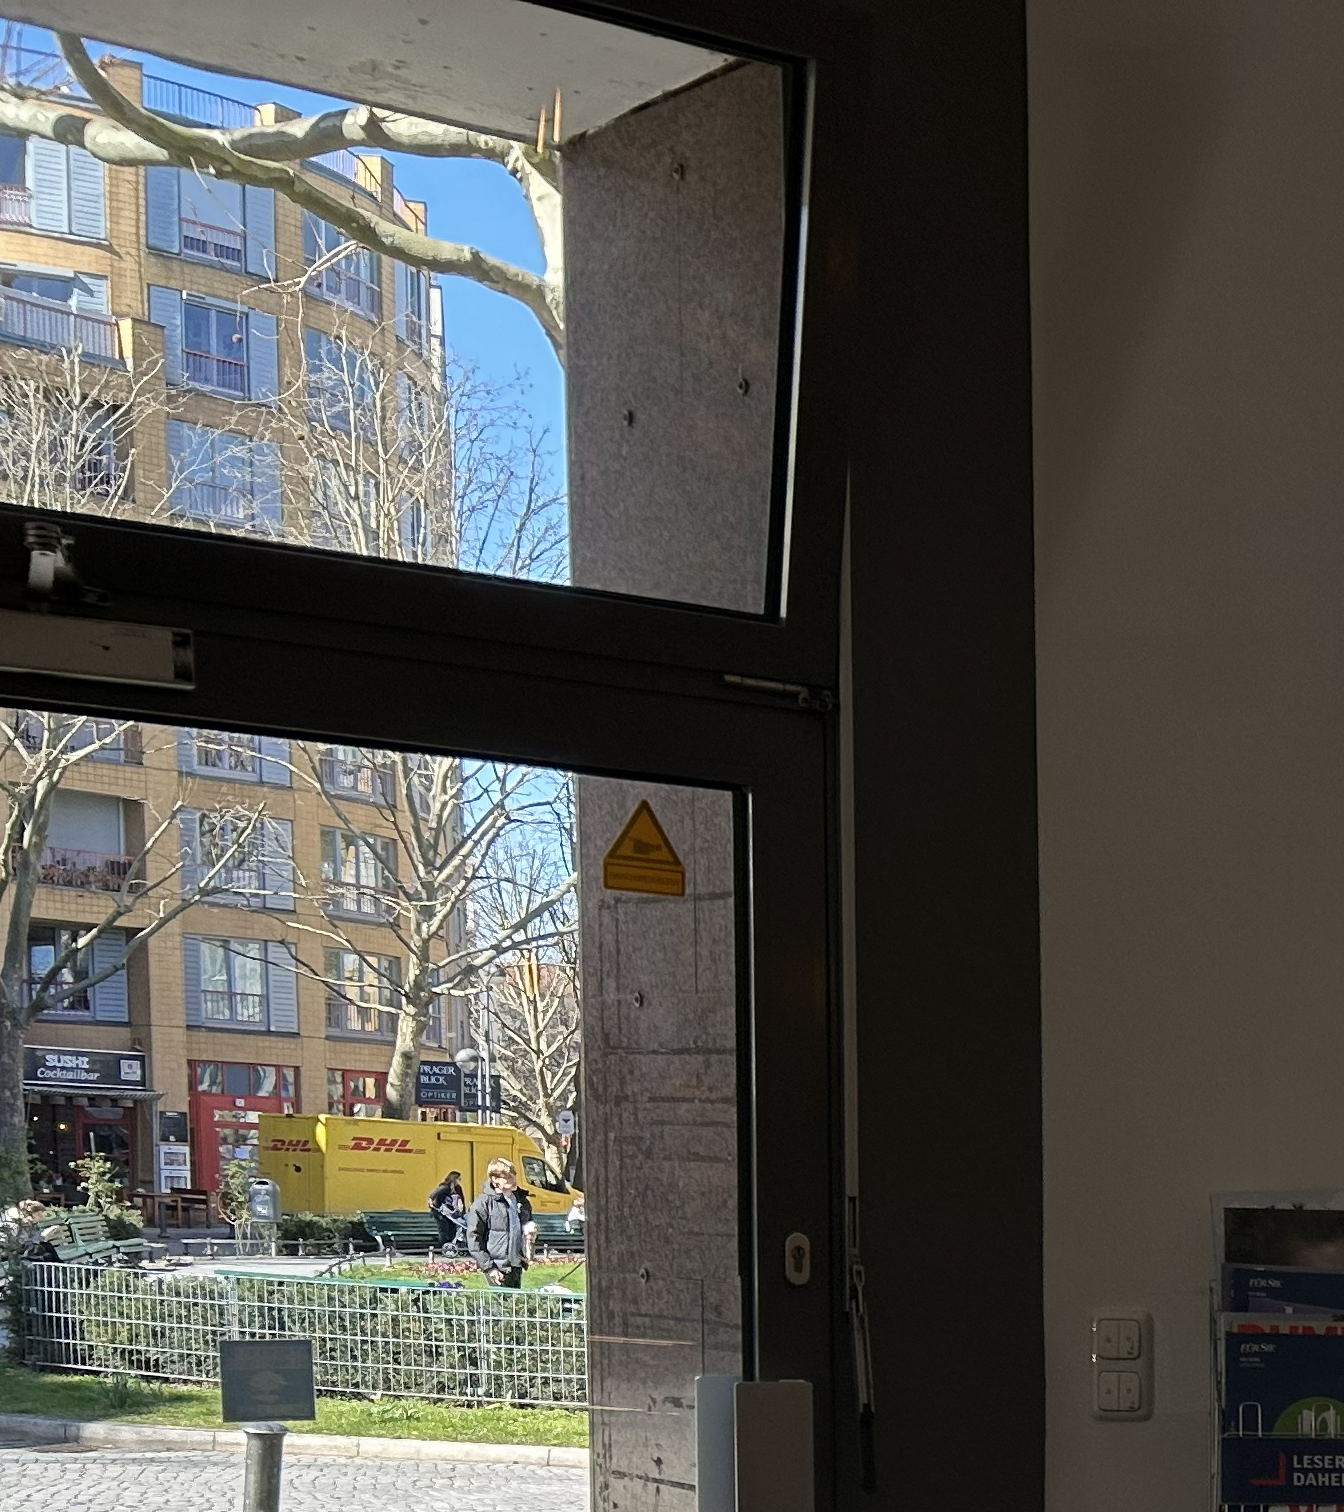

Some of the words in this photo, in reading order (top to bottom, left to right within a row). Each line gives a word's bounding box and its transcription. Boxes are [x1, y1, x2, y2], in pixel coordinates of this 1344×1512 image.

[45, 1054, 89, 1069] SUSHI
[36, 1067, 100, 1080] Cocktailbar
[420, 1064, 456, 1075] PRAGER
[420, 1075, 448, 1085] BLICK
[420, 1091, 457, 1099] OPTIKER
[350, 1136, 415, 1153] DHL
